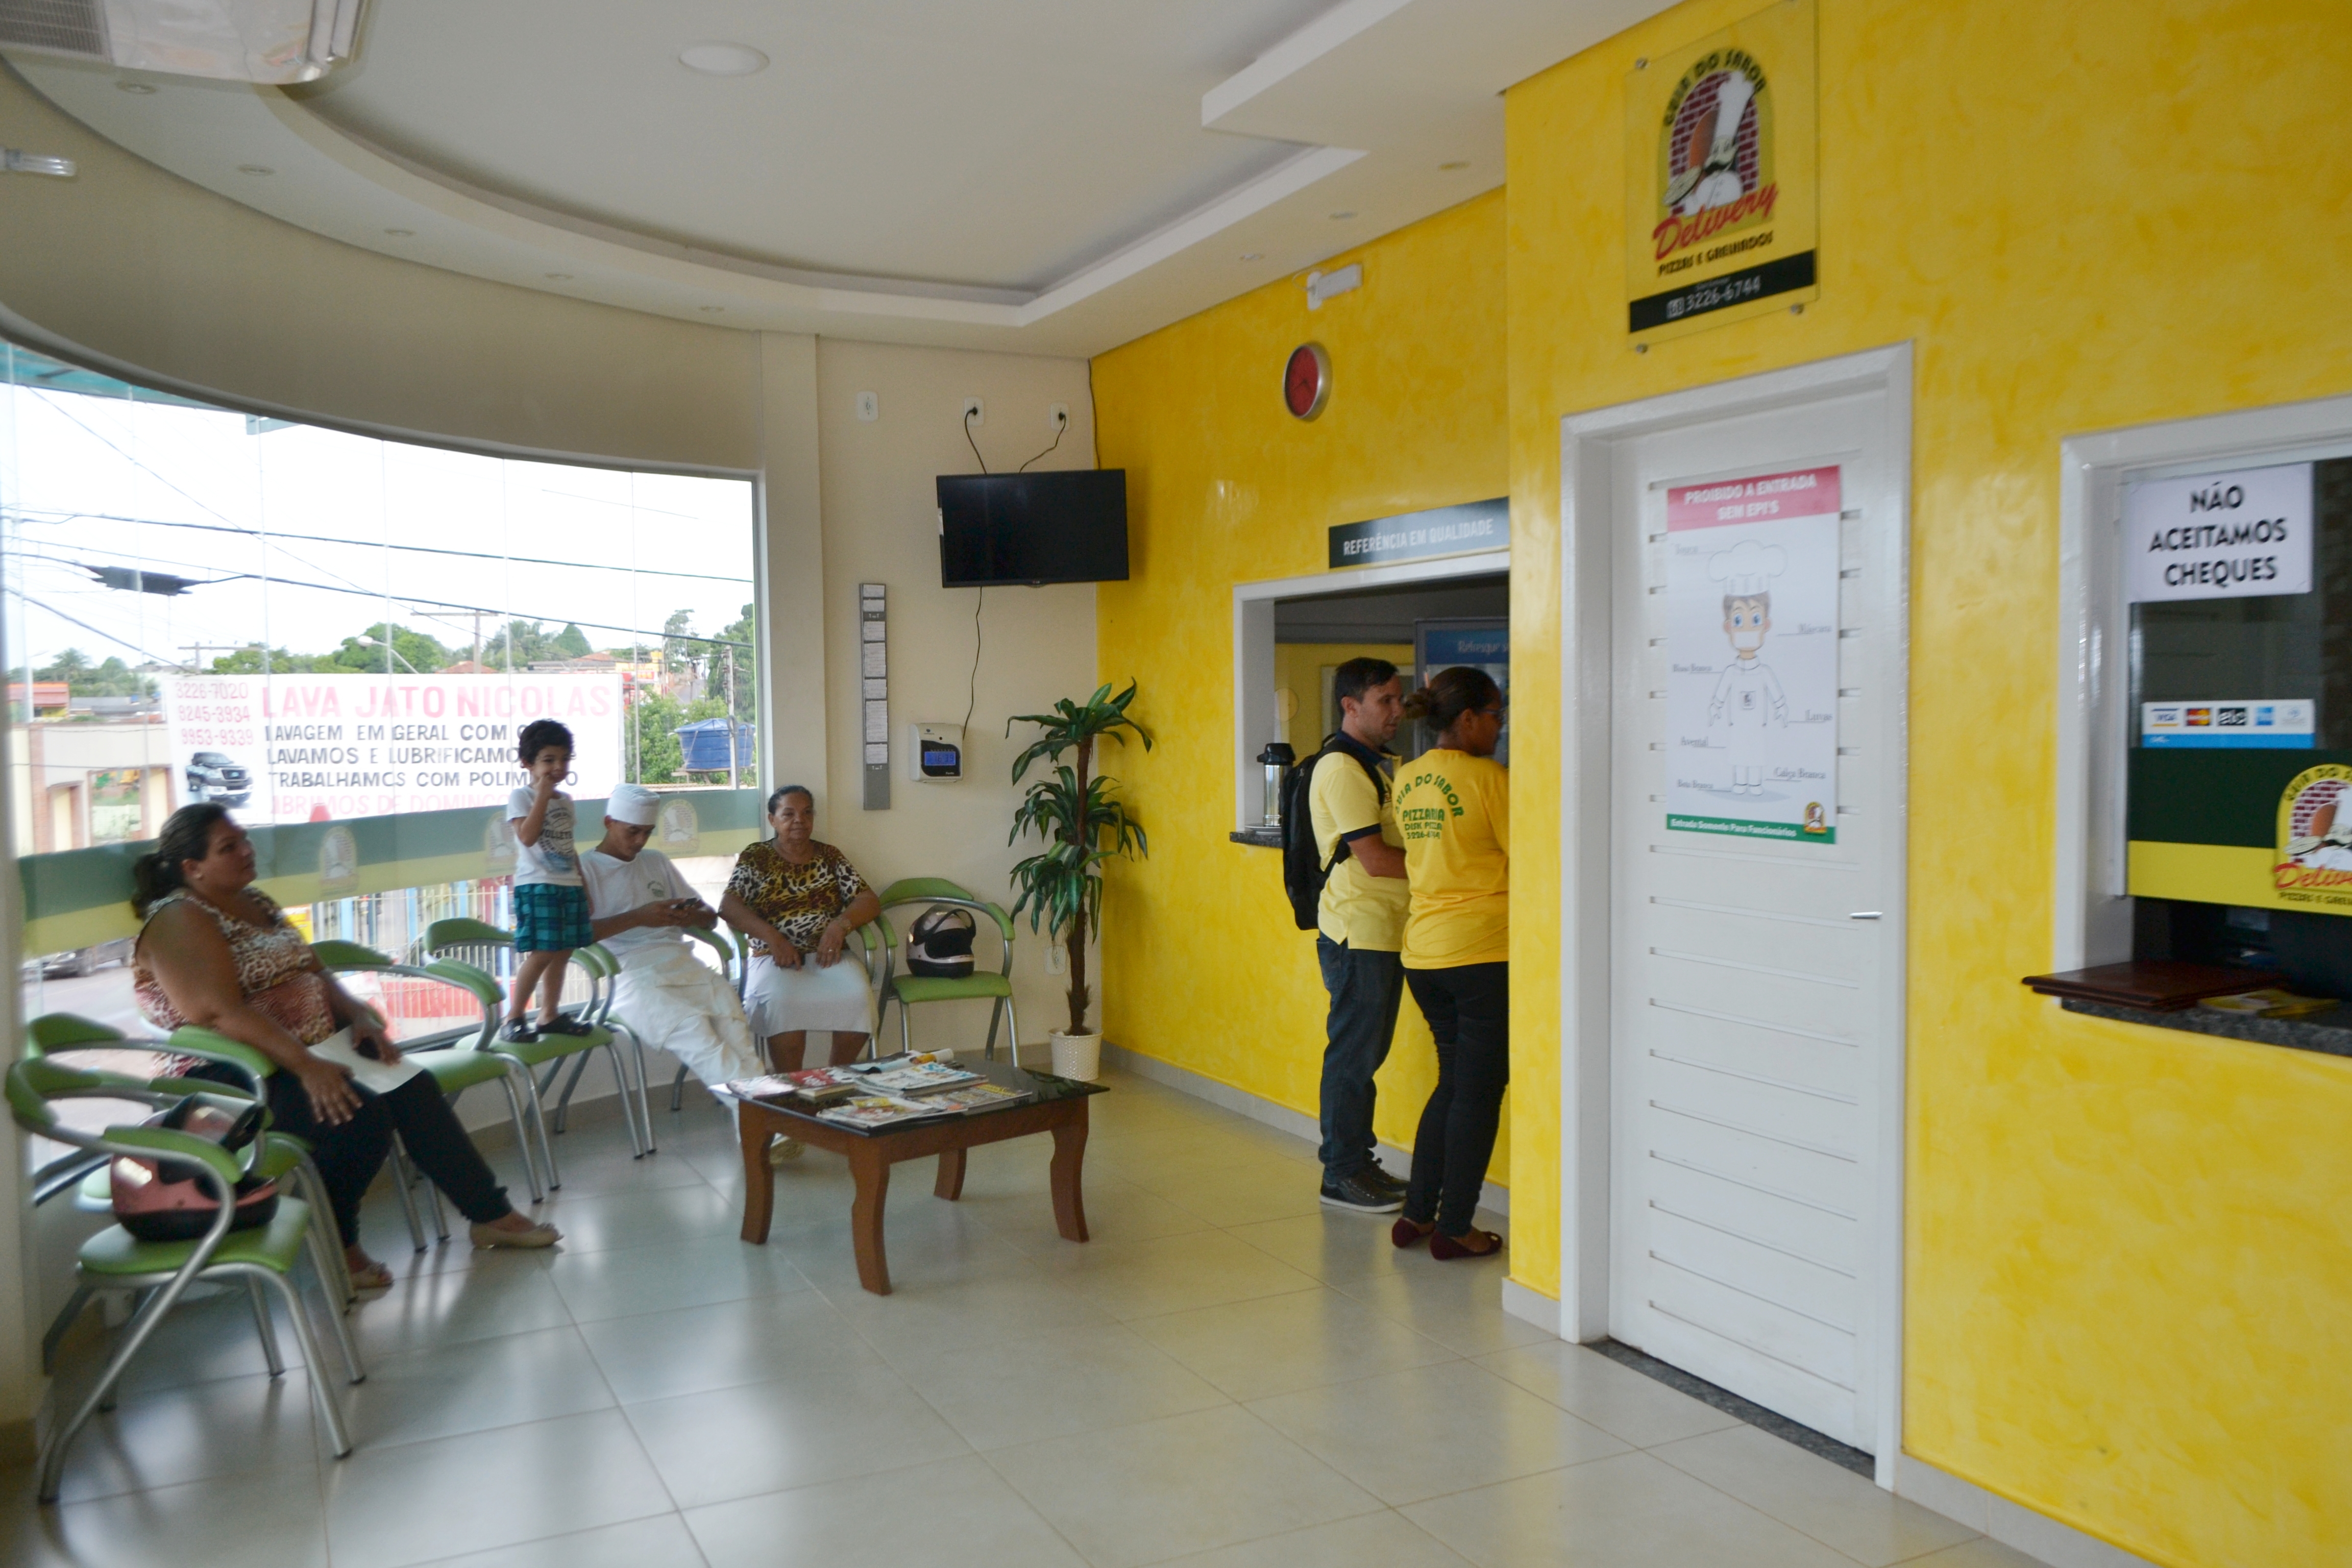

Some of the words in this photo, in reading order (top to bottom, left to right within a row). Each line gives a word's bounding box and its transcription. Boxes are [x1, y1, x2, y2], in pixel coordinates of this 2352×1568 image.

[1695, 52, 1720, 78] DO
[1652, 183, 1778, 261] Delivery
[1658, 254, 1694, 277] PIZZAS
[1696, 253, 1703, 266] E
[1707, 230, 1774, 261] GRELHADOS
[1685, 275, 1761, 311] 3226-6744
[1685, 485, 1743, 504] PROIBIDO
[1745, 483, 1755, 497] A
[1757, 474, 1816, 495] ENTRADA
[2190, 480, 2244, 513] NÃO
[1717, 504, 1745, 521] SEM
[1746, 500, 1780, 517] EPI'S
[1343, 532, 1408, 555] REFERÊNCIA
[1410, 529, 1427, 546] EM
[1430, 518, 1493, 543] QUALIDADE
[2148, 518, 2288, 553] ACEITAMOS
[2165, 556, 2276, 587] CHEQUES
[263, 685, 341, 717] LAVA
[356, 685, 446, 718] JATO
[457, 685, 611, 717] NICOLAS
[1805, 709, 1833, 721] Luvas
[357, 725, 384, 741] EM
[392, 724, 450, 741] GERAL
[460, 724, 506, 741] COM
[267, 747, 359, 765] LAVAMOS
[371, 748, 378, 764] E
[389, 747, 519, 764] LUBRIFICAMO
[416, 771, 460, 787] COM
[470, 771, 578, 786] POLIMO
[1416, 773, 1433, 787] DO
[1434, 775, 1464, 817] SABOR
[1403, 808, 1445, 821] PIZZARIA
[1670, 818, 1697, 828] Entrada
[1698, 820, 1729, 831] Somente
[1731, 823, 1747, 833] Para
[1748, 824, 1797, 838] Funcionários
